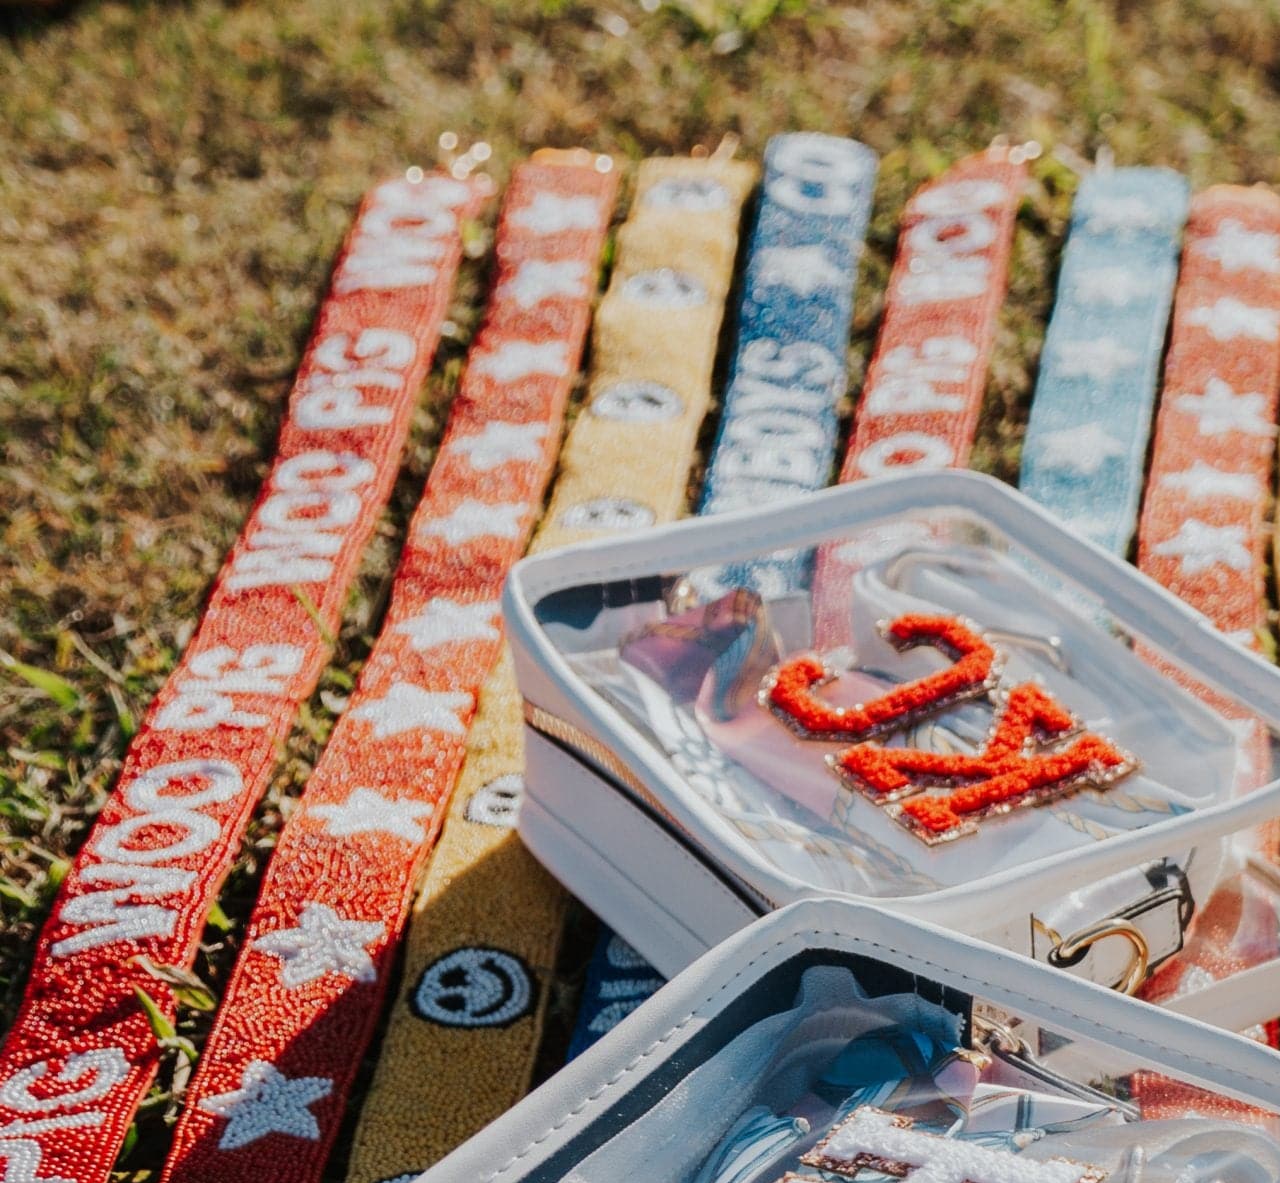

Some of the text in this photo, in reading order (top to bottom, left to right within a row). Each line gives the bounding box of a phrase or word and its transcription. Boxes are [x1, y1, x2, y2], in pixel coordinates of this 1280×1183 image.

[294, 326, 418, 432] PIG
[868, 334, 980, 416] PIG
[224, 450, 376, 594] WOO
[151, 642, 304, 734] PIG
[50, 757, 245, 957] WOO
